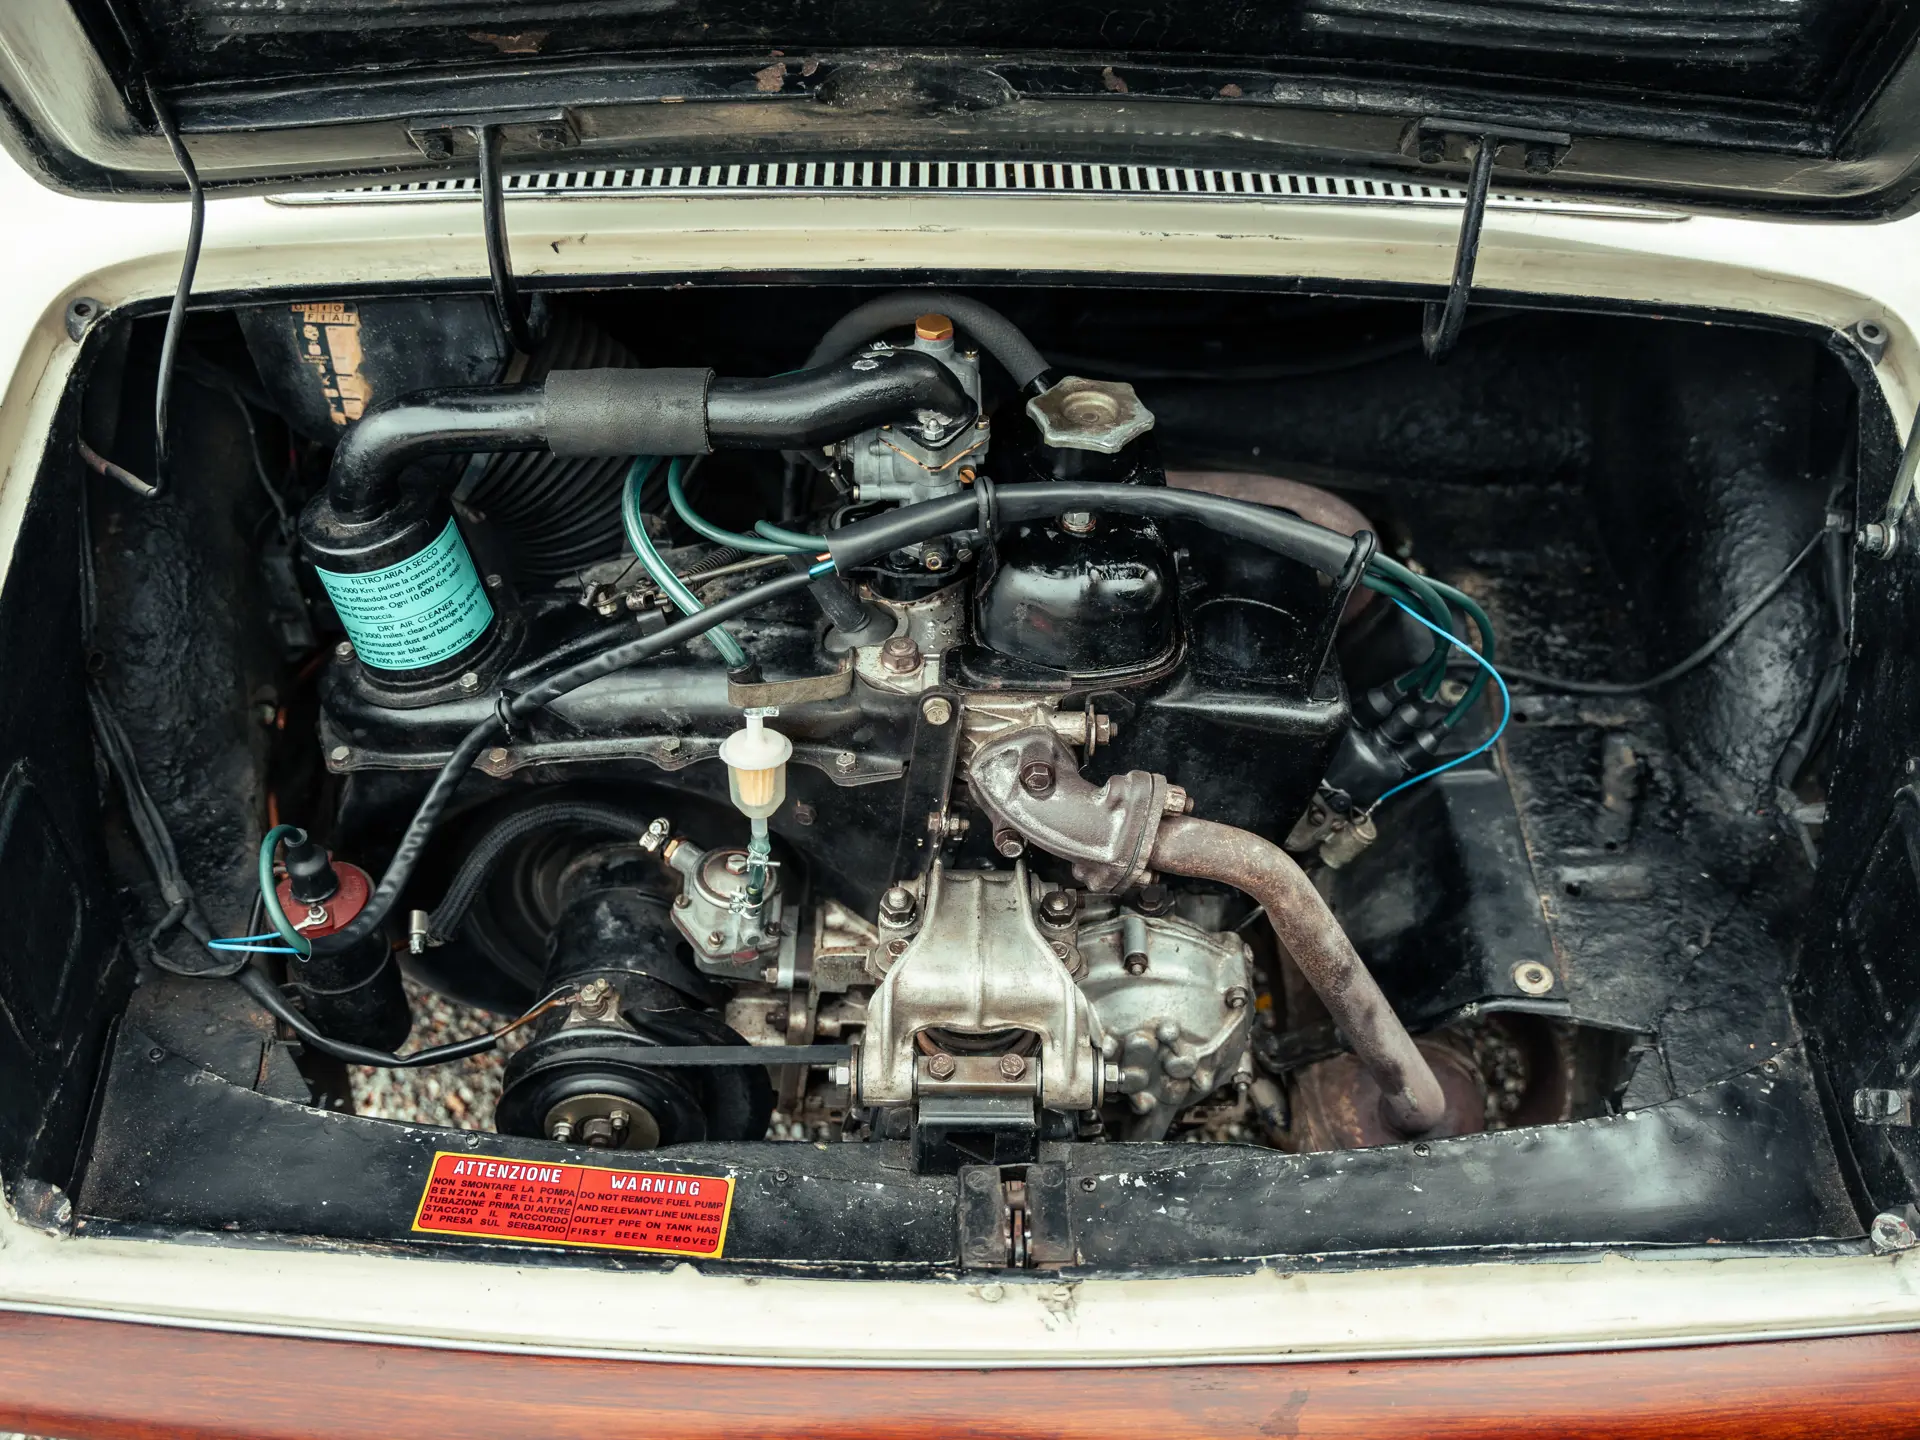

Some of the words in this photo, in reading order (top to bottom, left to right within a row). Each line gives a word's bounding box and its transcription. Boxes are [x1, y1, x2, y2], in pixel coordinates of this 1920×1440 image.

[294, 304, 342, 312] OLIO
[308, 314, 352, 322] FIAT
[351, 576, 382, 584] FILTRO
[384, 569, 404, 580] ARIA
[412, 548, 438, 568] SECCO
[378, 580, 400, 592] pulire
[410, 560, 440, 580] cartuccia
[390, 590, 404, 599] con
[417, 576, 436, 590] getto
[436, 562, 452, 576] d'aria
[388, 600, 408, 608] Ogni
[410, 586, 434, 602] 10.000
[435, 578, 448, 588] Km.
[407, 625, 427, 636] clean
[428, 607, 458, 628] cartridge
[458, 601, 466, 609] by
[418, 600, 454, 623] CLEANER
[404, 637, 421, 646] dust
[422, 631, 436, 640] and
[437, 615, 464, 634] blowing
[464, 602, 474, 616] with
[366, 648, 396, 656] pressure
[408, 645, 429, 654] blast.
[418, 648, 446, 662] replace
[447, 628, 476, 650] cartridge.
[453, 1160, 562, 1184] ATTENZIONE
[433, 1178, 456, 1186] NON
[460, 1180, 516, 1192] SMONTARE
[540, 1187, 576, 1198] POMPA
[610, 1175, 700, 1196] WARNING
[428, 1196, 485, 1208] TUBAZIONE
[488, 1201, 520, 1210] PRIMA
[536, 1206, 570, 1216] AVERE
[431, 1187, 486, 1198] BENZINA
[511, 1194, 573, 1206] RELATIVA
[580, 1191, 595, 1199] DO
[598, 1193, 619, 1202] NOT
[621, 1195, 664, 1205] REMOVE
[666, 1198, 692, 1208] FUEL
[694, 1201, 724, 1210] PUMP
[424, 1204, 478, 1216] STACCATO
[510, 1212, 568, 1224] RACCORDO
[576, 1204, 598, 1212] AND
[600, 1206, 654, 1217] RELEVANT
[656, 1210, 678, 1218] LINE
[680, 1212, 720, 1222] UNLESS
[439, 1215, 473, 1224] PRESA
[480, 1218, 500, 1227] SUL
[507, 1221, 566, 1234] SERBATOIO
[574, 1216, 614, 1226] OUTLET
[618, 1219, 642, 1228] PIPE
[666, 1224, 692, 1232] TANK
[696, 1226, 718, 1234] HAS
[570, 1228, 606, 1236] FIRST
[614, 1231, 648, 1240] BEEN
[656, 1234, 716, 1246] REMOVED
